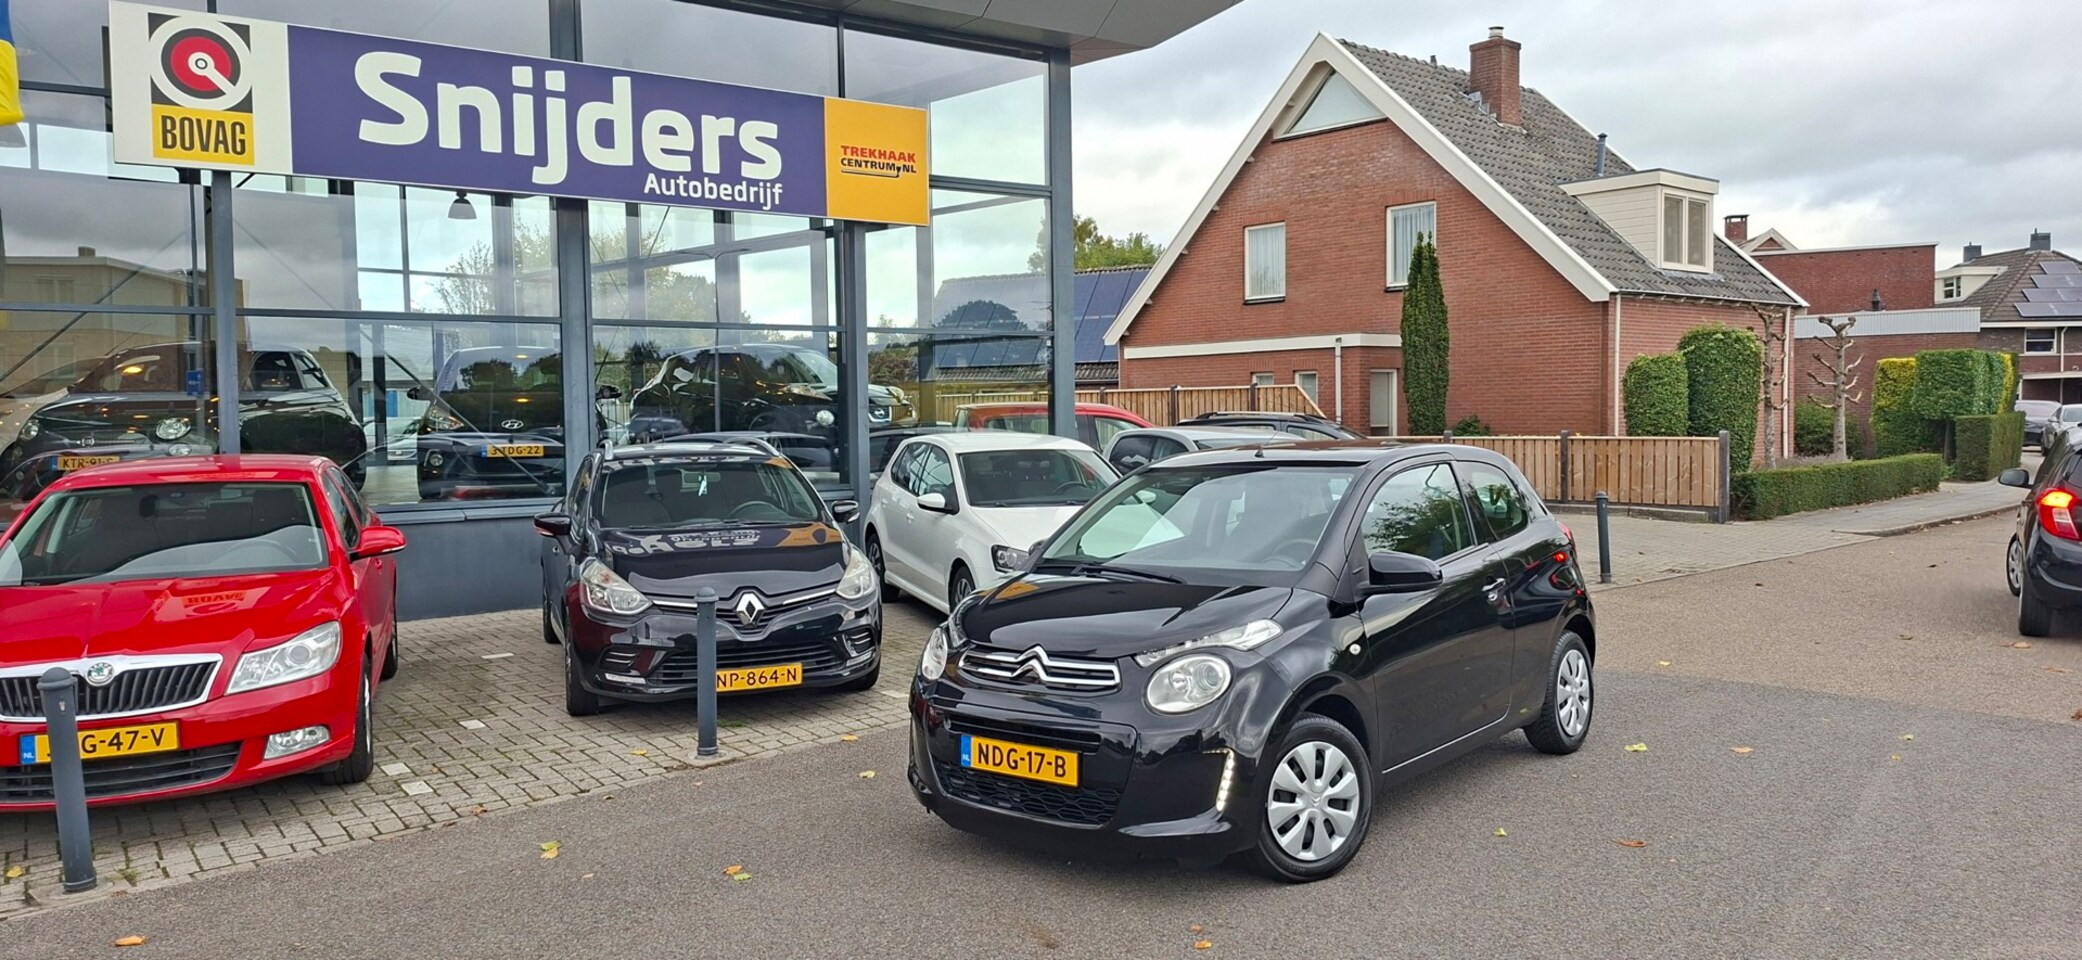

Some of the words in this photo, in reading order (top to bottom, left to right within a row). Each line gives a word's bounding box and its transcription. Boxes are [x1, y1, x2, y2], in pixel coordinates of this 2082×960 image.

[161, 115, 247, 156] BOVAG
[354, 51, 783, 185] Snijders
[840, 145, 917, 163] TREKHAAK
[644, 173, 783, 211] Autobedrijf
[716, 667, 797, 688] NP-864-N
[978, 742, 1067, 778] NDG-17-B
